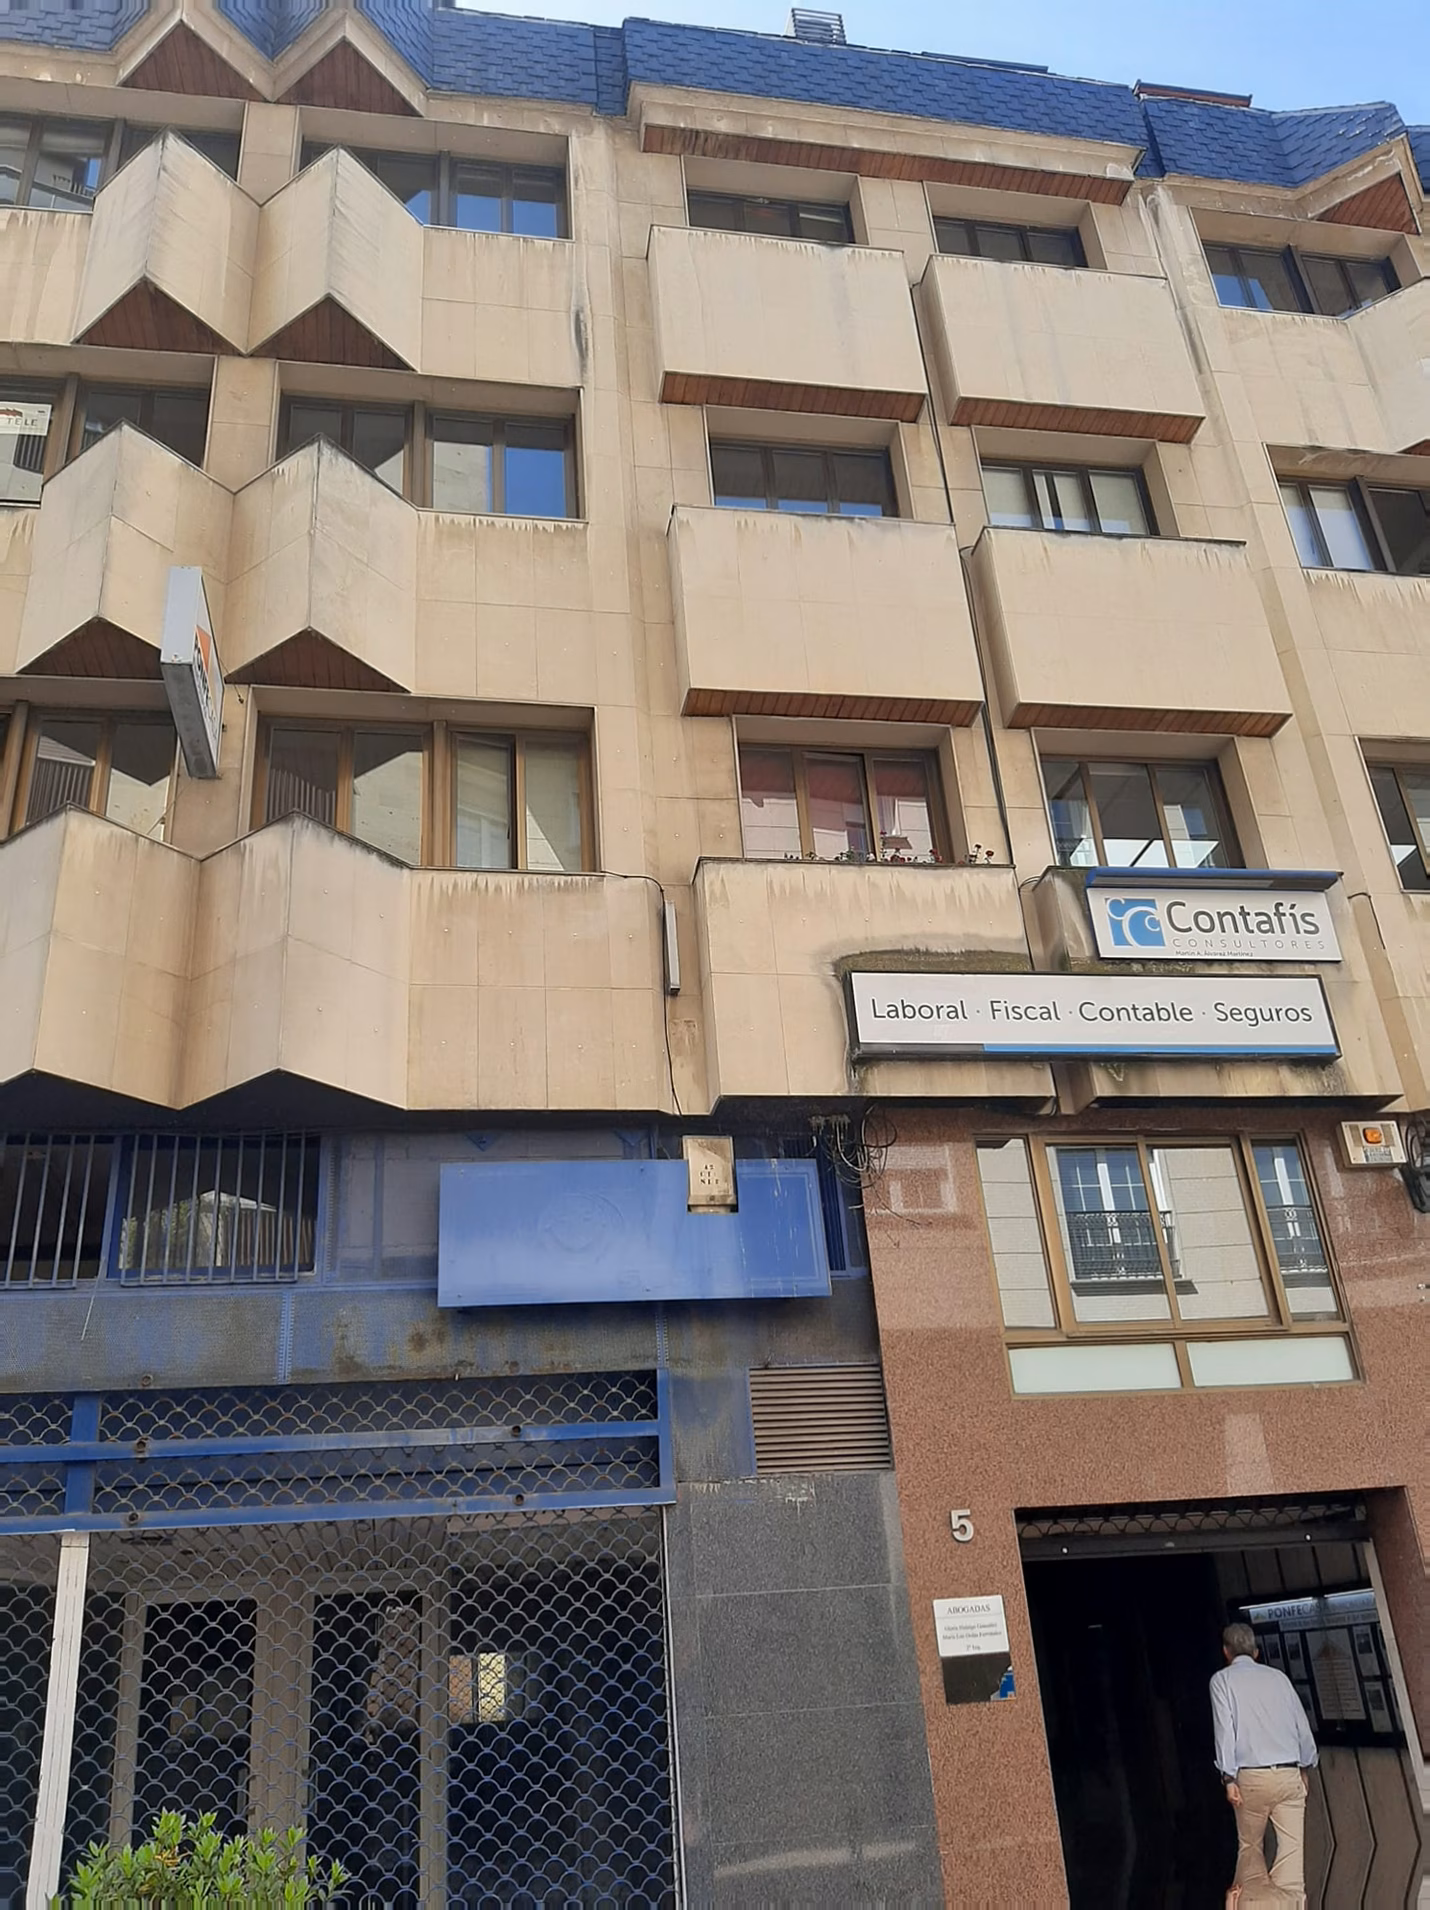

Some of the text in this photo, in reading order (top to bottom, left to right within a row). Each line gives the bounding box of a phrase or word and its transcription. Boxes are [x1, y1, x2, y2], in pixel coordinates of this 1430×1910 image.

[1165, 899, 1321, 936] Contafís
[1172, 938, 1325, 950] CONSULTORES
[872, 998, 1313, 1027] Laboral Fiscal Contable Seguros
[949, 1508, 975, 1544] 5
[947, 1604, 991, 1614] ABOGADAS
